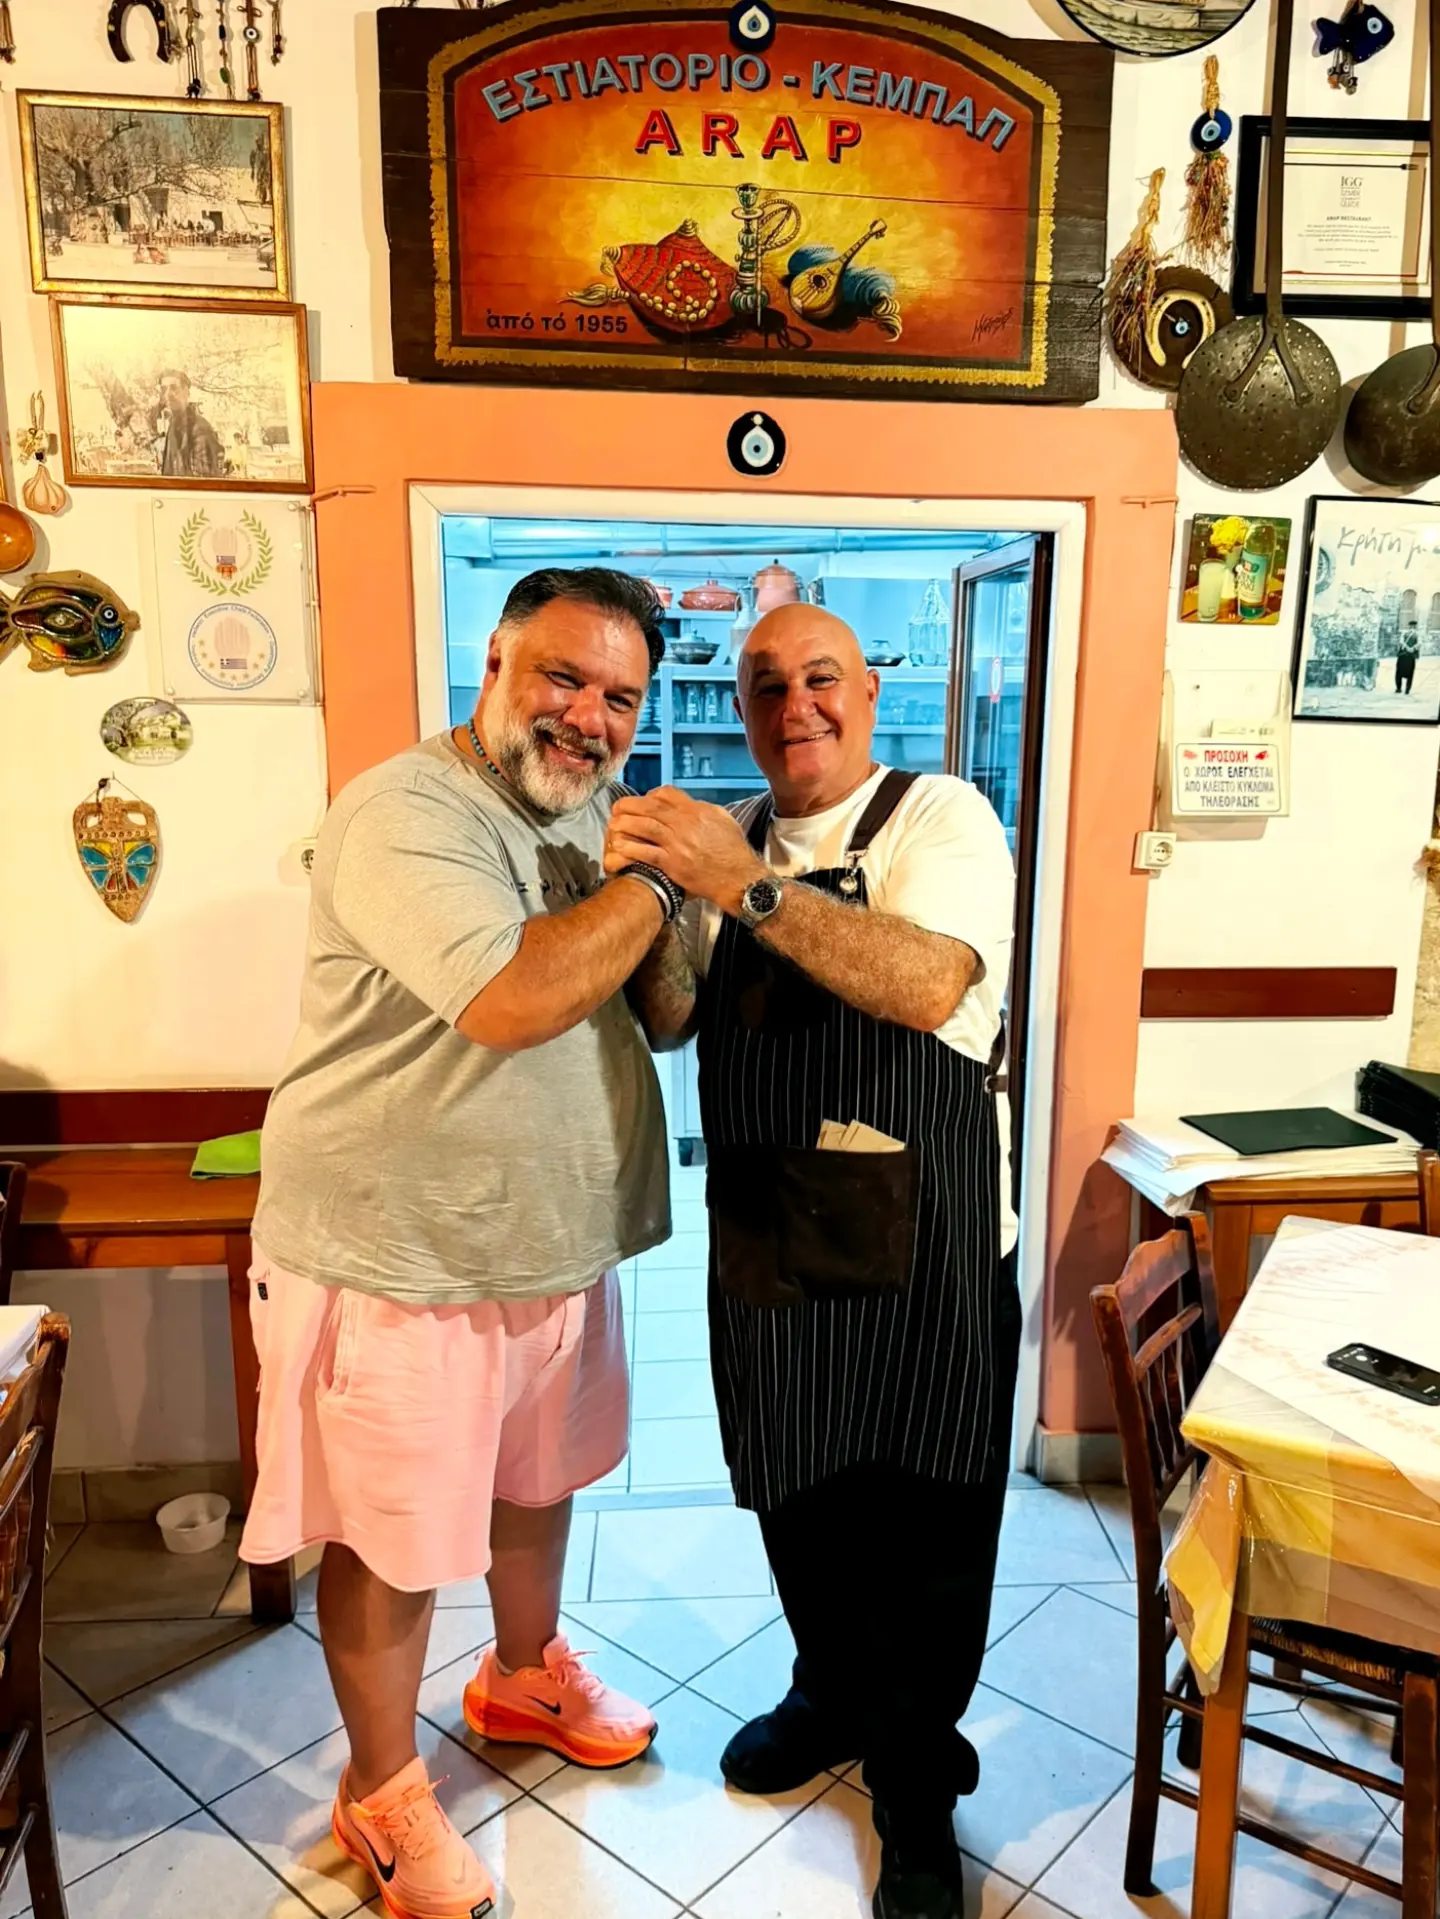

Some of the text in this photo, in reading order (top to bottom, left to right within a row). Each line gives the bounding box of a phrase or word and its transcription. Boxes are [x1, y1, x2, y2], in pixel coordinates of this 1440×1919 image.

[481, 52, 770, 122] ΕΣΤΙΑΤΟΡΙΟ
[811, 60, 1016, 149] ΚΕΜΠΑΠ
[635, 109, 861, 162] ARAP
[575, 313, 628, 333] 1955
[1204, 750, 1248, 763] ΠΡΟΣΟΧΗ
[1183, 766, 1274, 778] Ο ΧΩΡΟΣ ΕΛΕΓΧΕΤΑΙ
[1185, 781, 1275, 793] ΑΠΟ ΚΛΕΙΣΤΟ ΚΥΚΛΩΜΑ
[1200, 796, 1260, 808] ΤΗΛΕΟΡΑΣΗΣ
